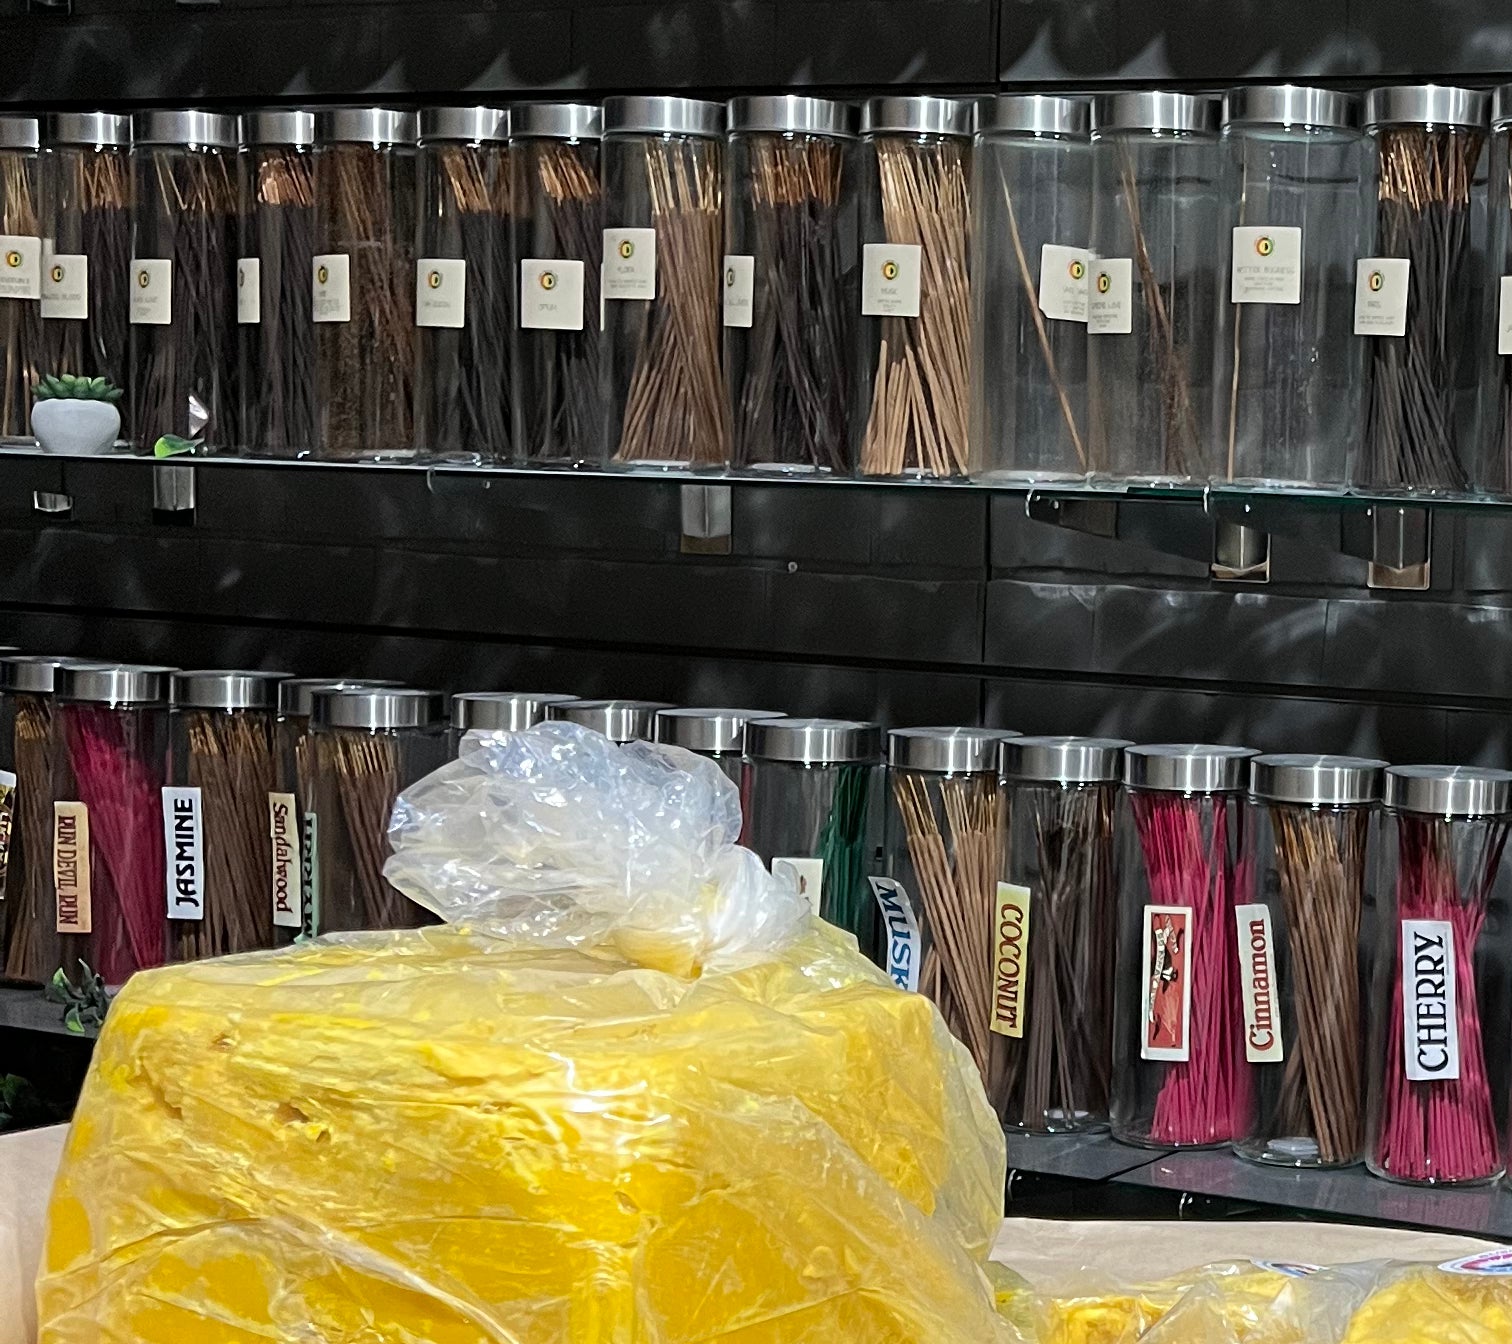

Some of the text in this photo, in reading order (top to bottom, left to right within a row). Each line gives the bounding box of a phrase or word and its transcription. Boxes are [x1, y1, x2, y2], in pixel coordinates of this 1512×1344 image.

[57, 814, 79, 925] RUN DEVIL RUN
[172, 796, 197, 908] JASMINE
[271, 802, 295, 914] Sandalwood
[876, 883, 914, 990] MUSK
[995, 903, 1025, 1030] COCONUT
[1248, 918, 1273, 1050] Cinnamon
[1415, 931, 1449, 1072] CHERRY
